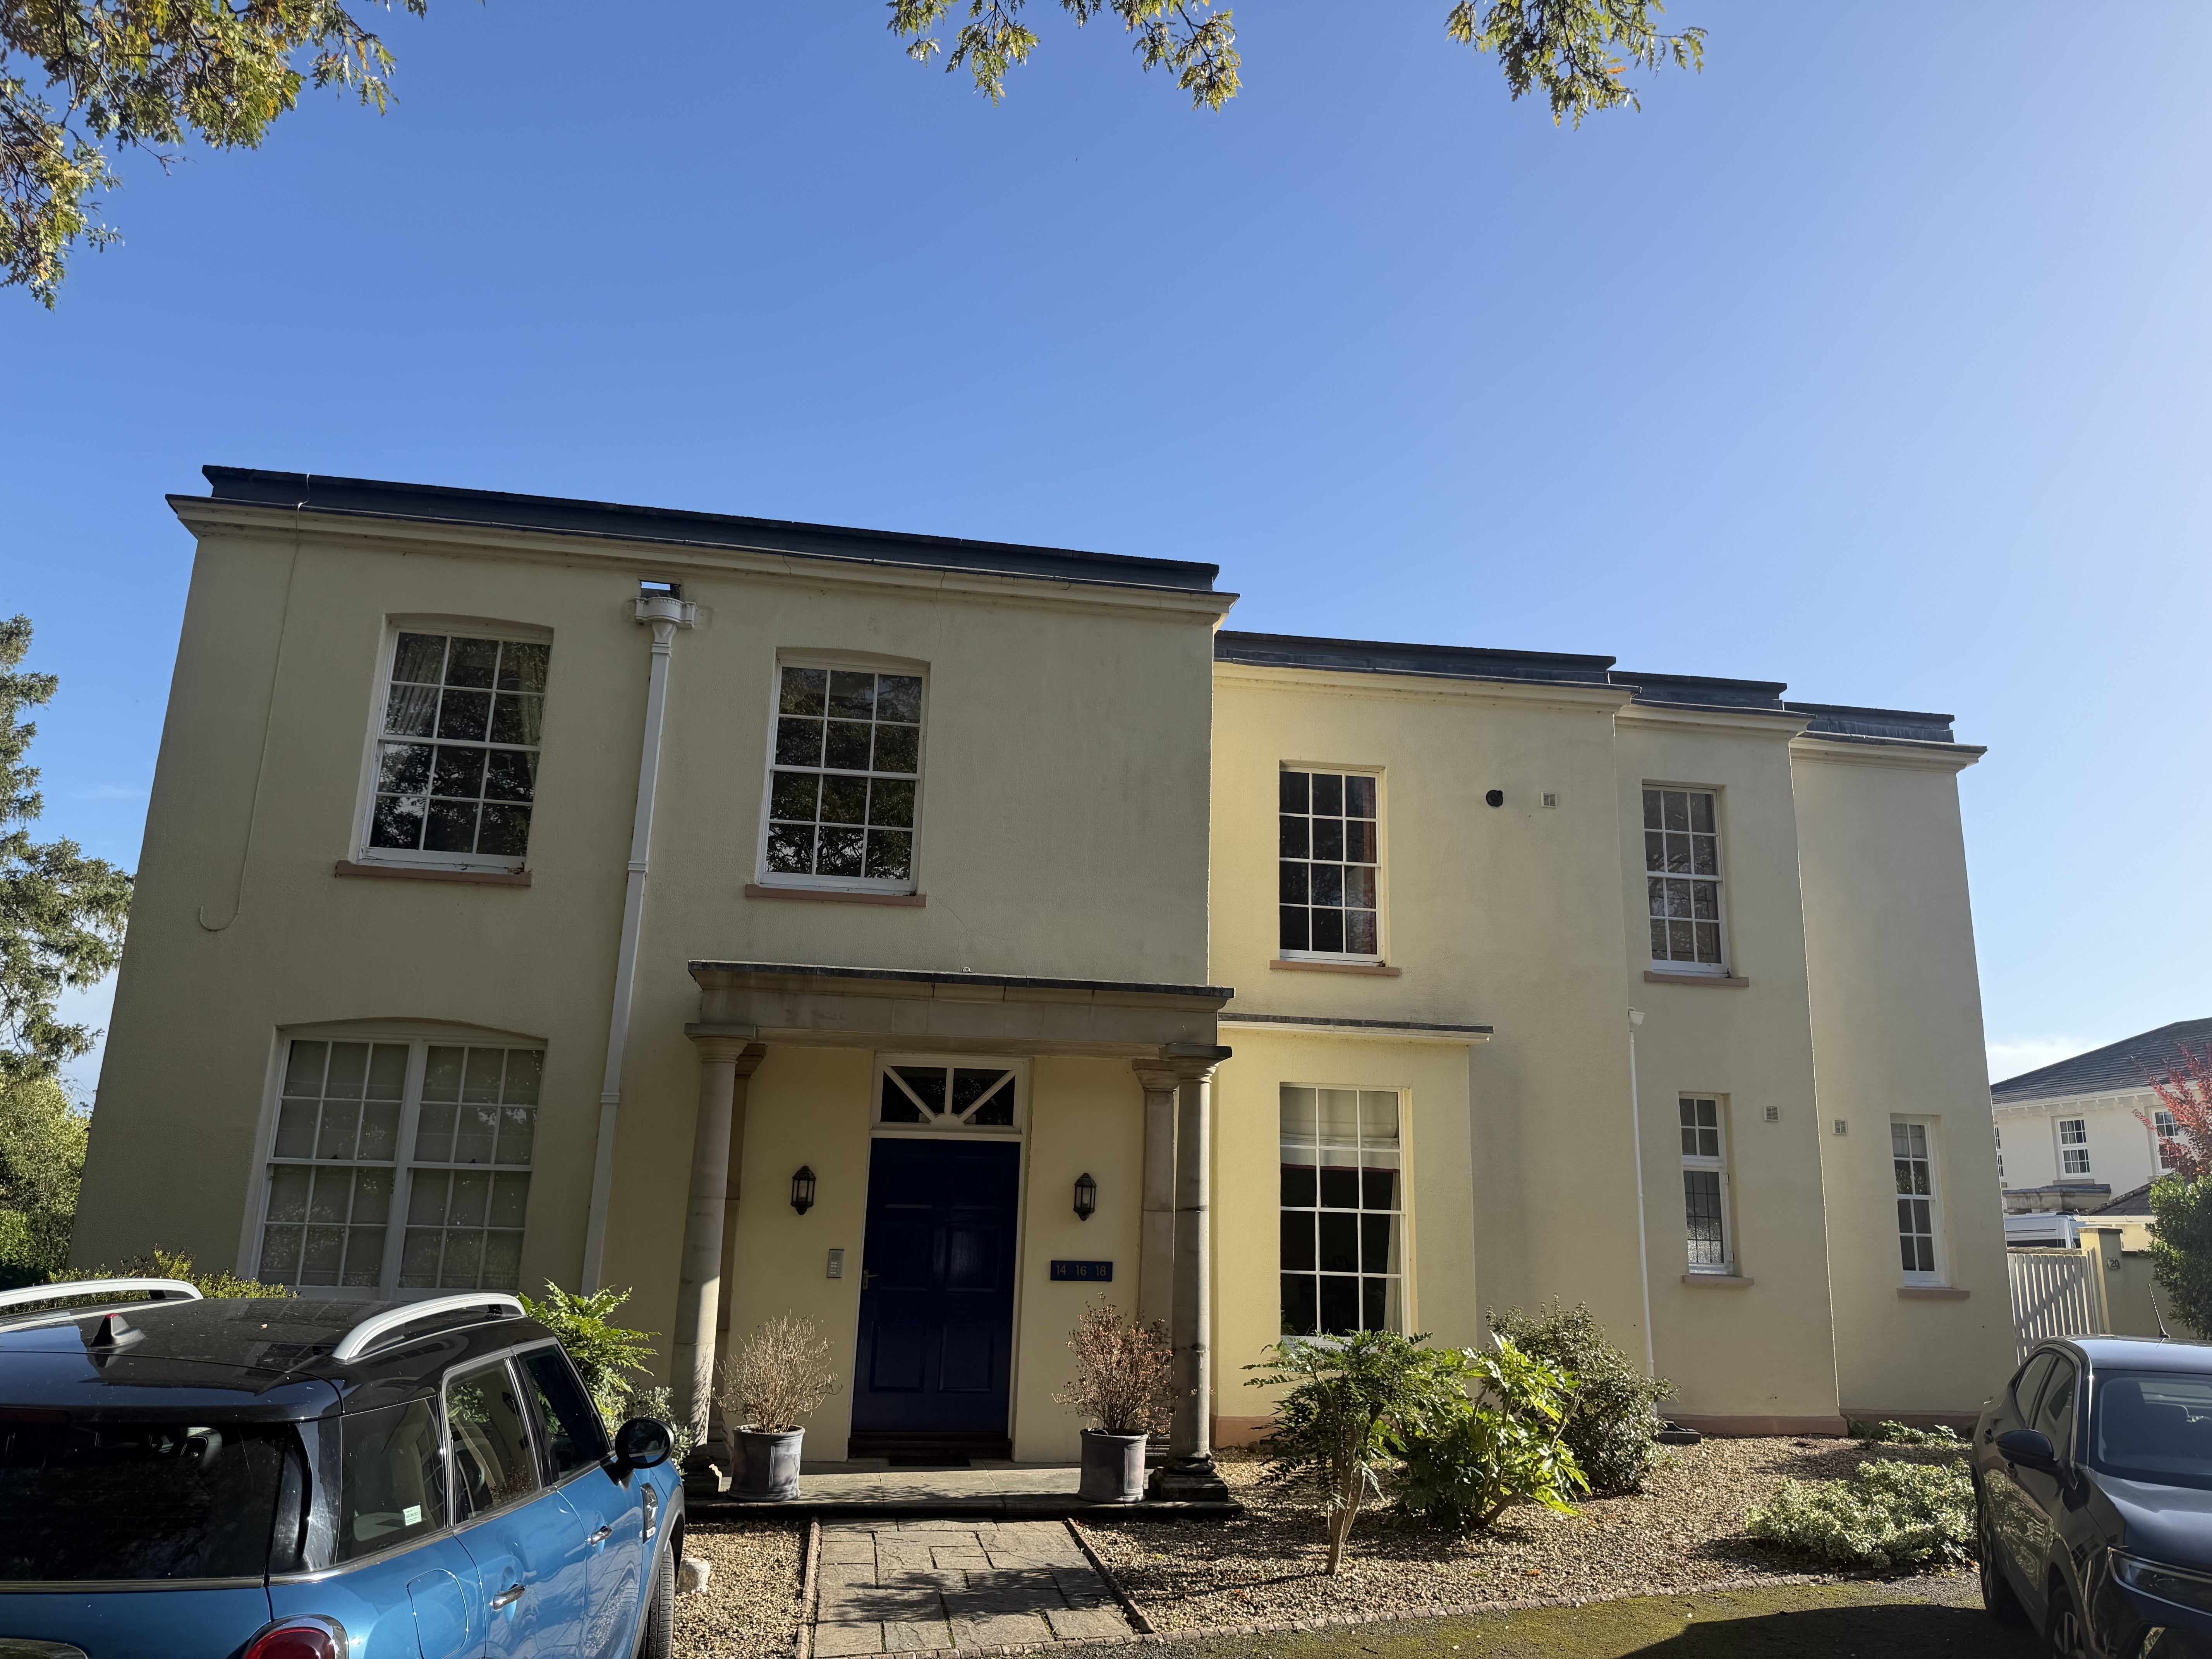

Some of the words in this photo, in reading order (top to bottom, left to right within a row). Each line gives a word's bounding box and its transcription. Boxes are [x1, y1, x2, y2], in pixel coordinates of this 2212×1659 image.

[2110, 1259, 2119, 1267] 20
[1056, 1264, 1066, 1275] 14
[1076, 1265, 1087, 1276] 16
[1096, 1265, 1106, 1276] 18
